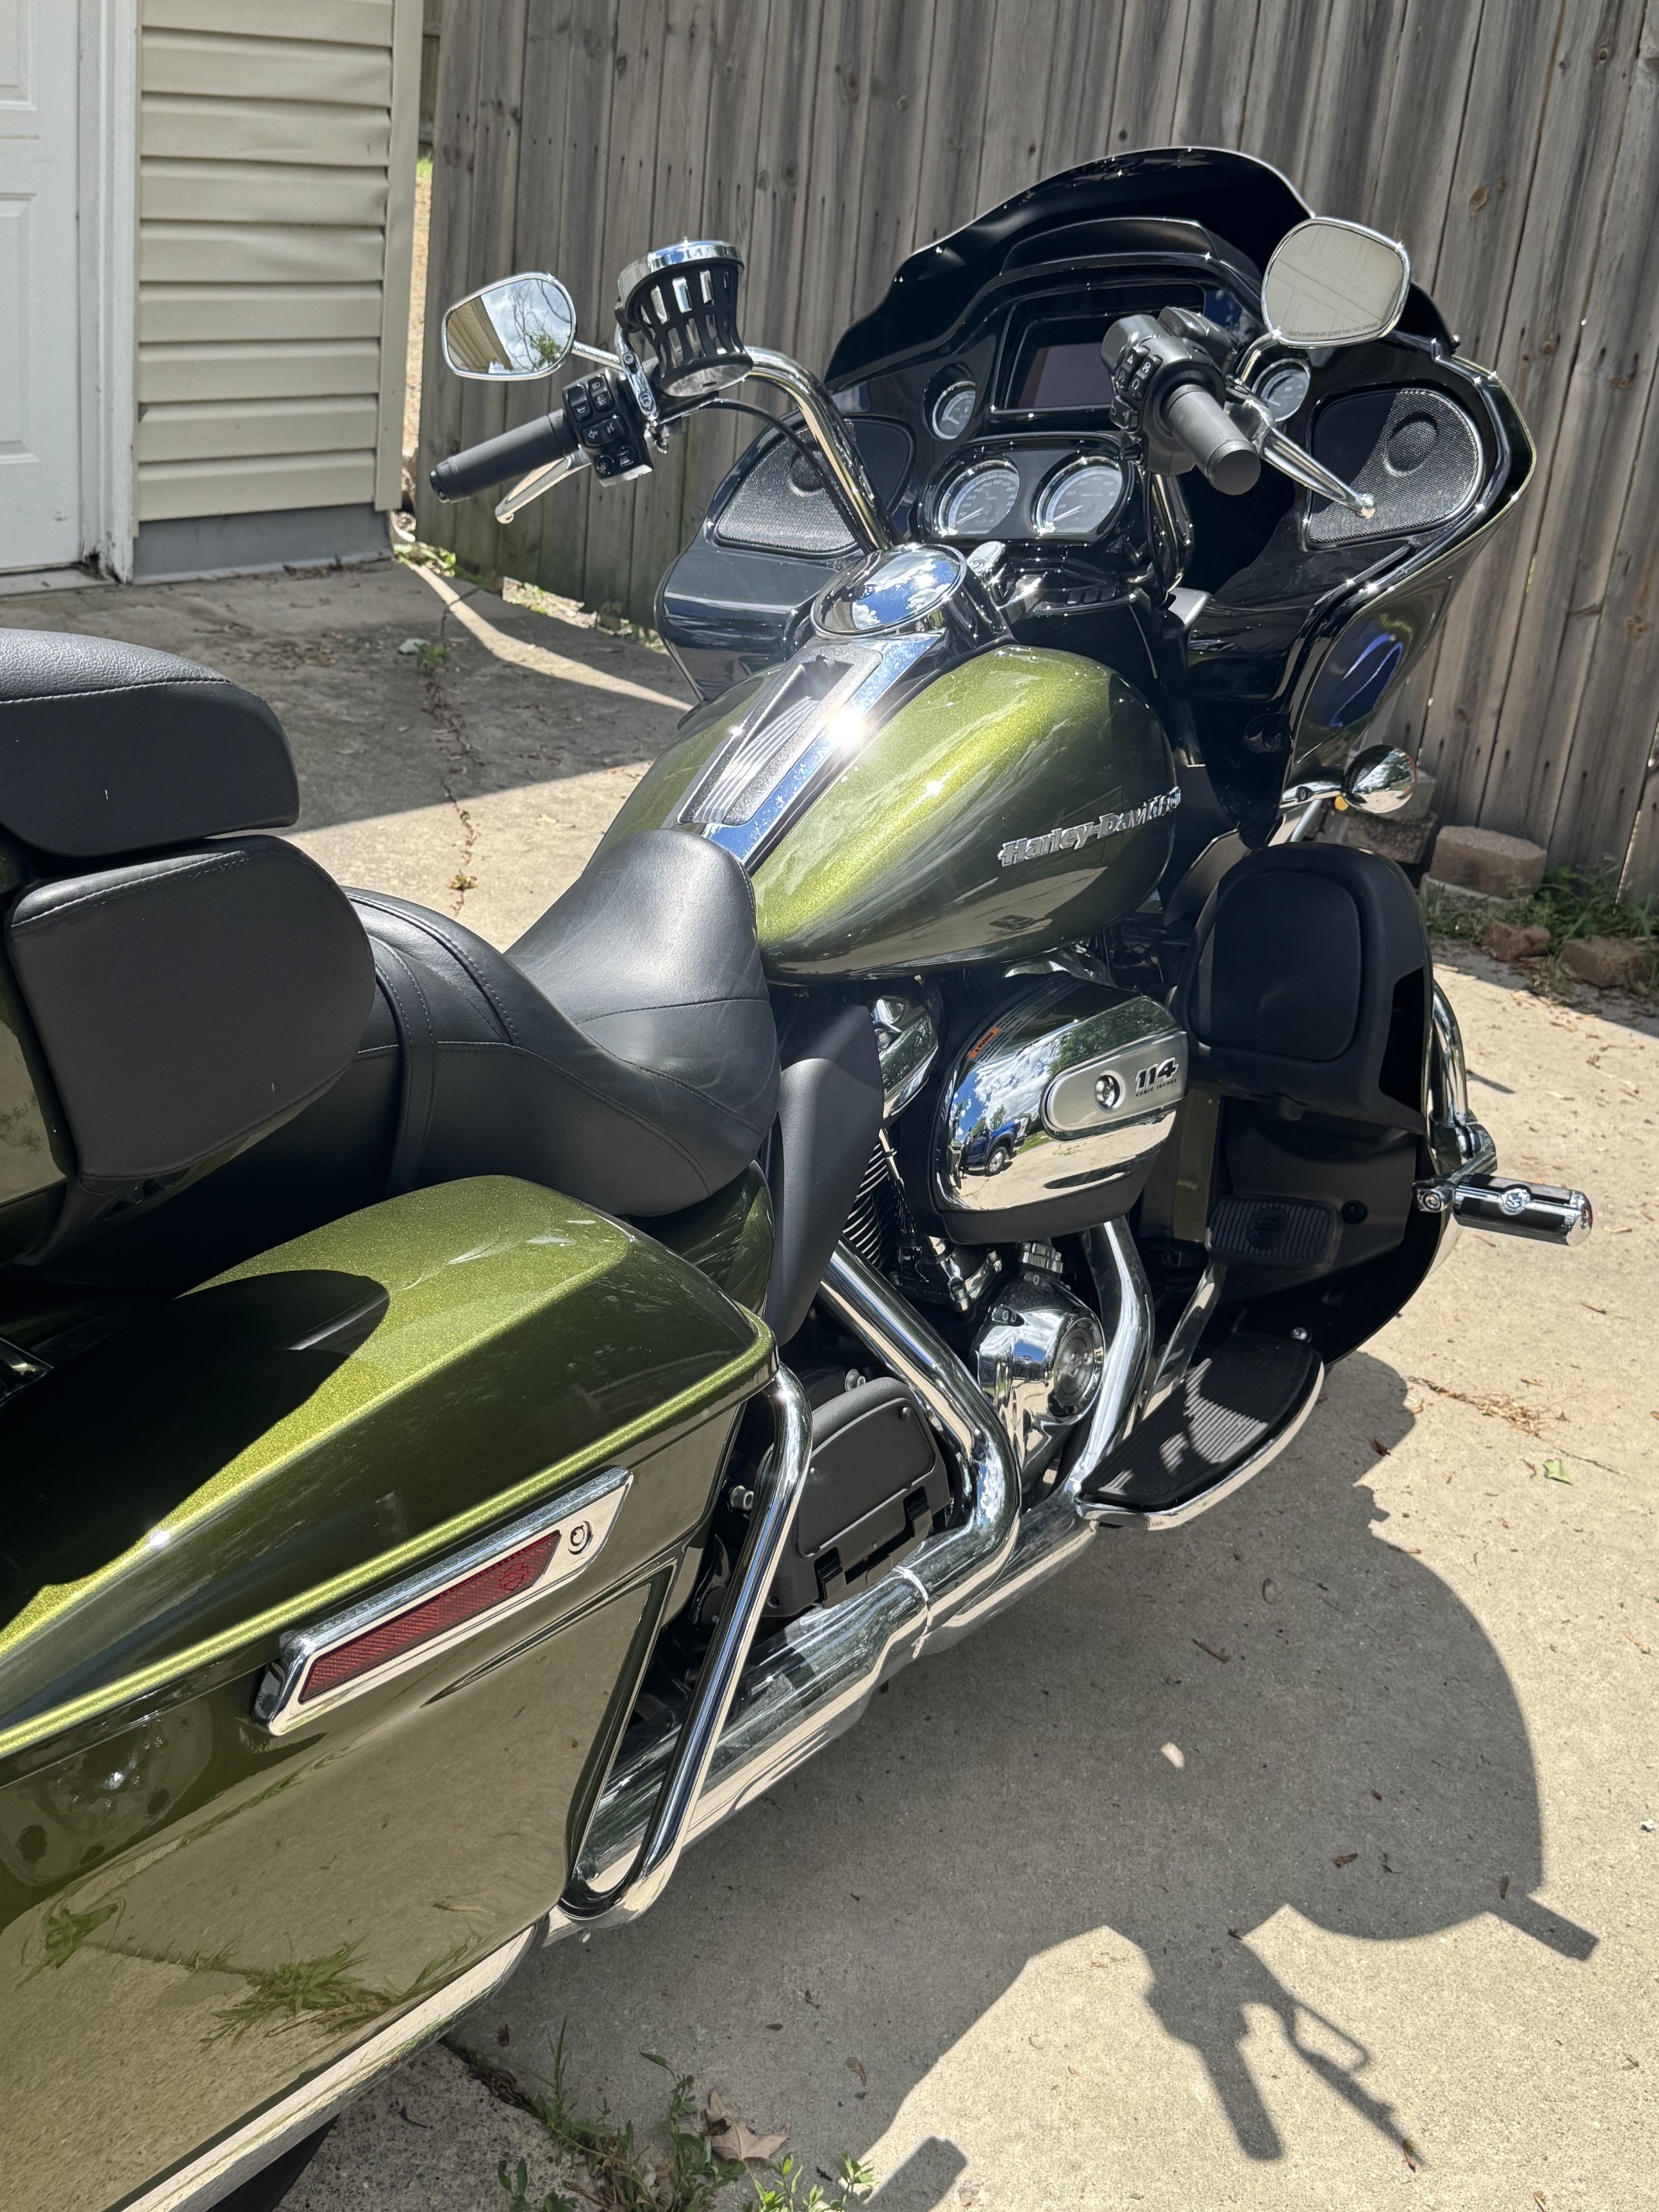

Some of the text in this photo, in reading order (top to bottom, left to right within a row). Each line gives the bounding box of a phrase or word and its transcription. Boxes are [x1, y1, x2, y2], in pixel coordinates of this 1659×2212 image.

[1135, 1056, 1179, 1092] 114
[1135, 1078, 1176, 1097] CUBIC INCHES
